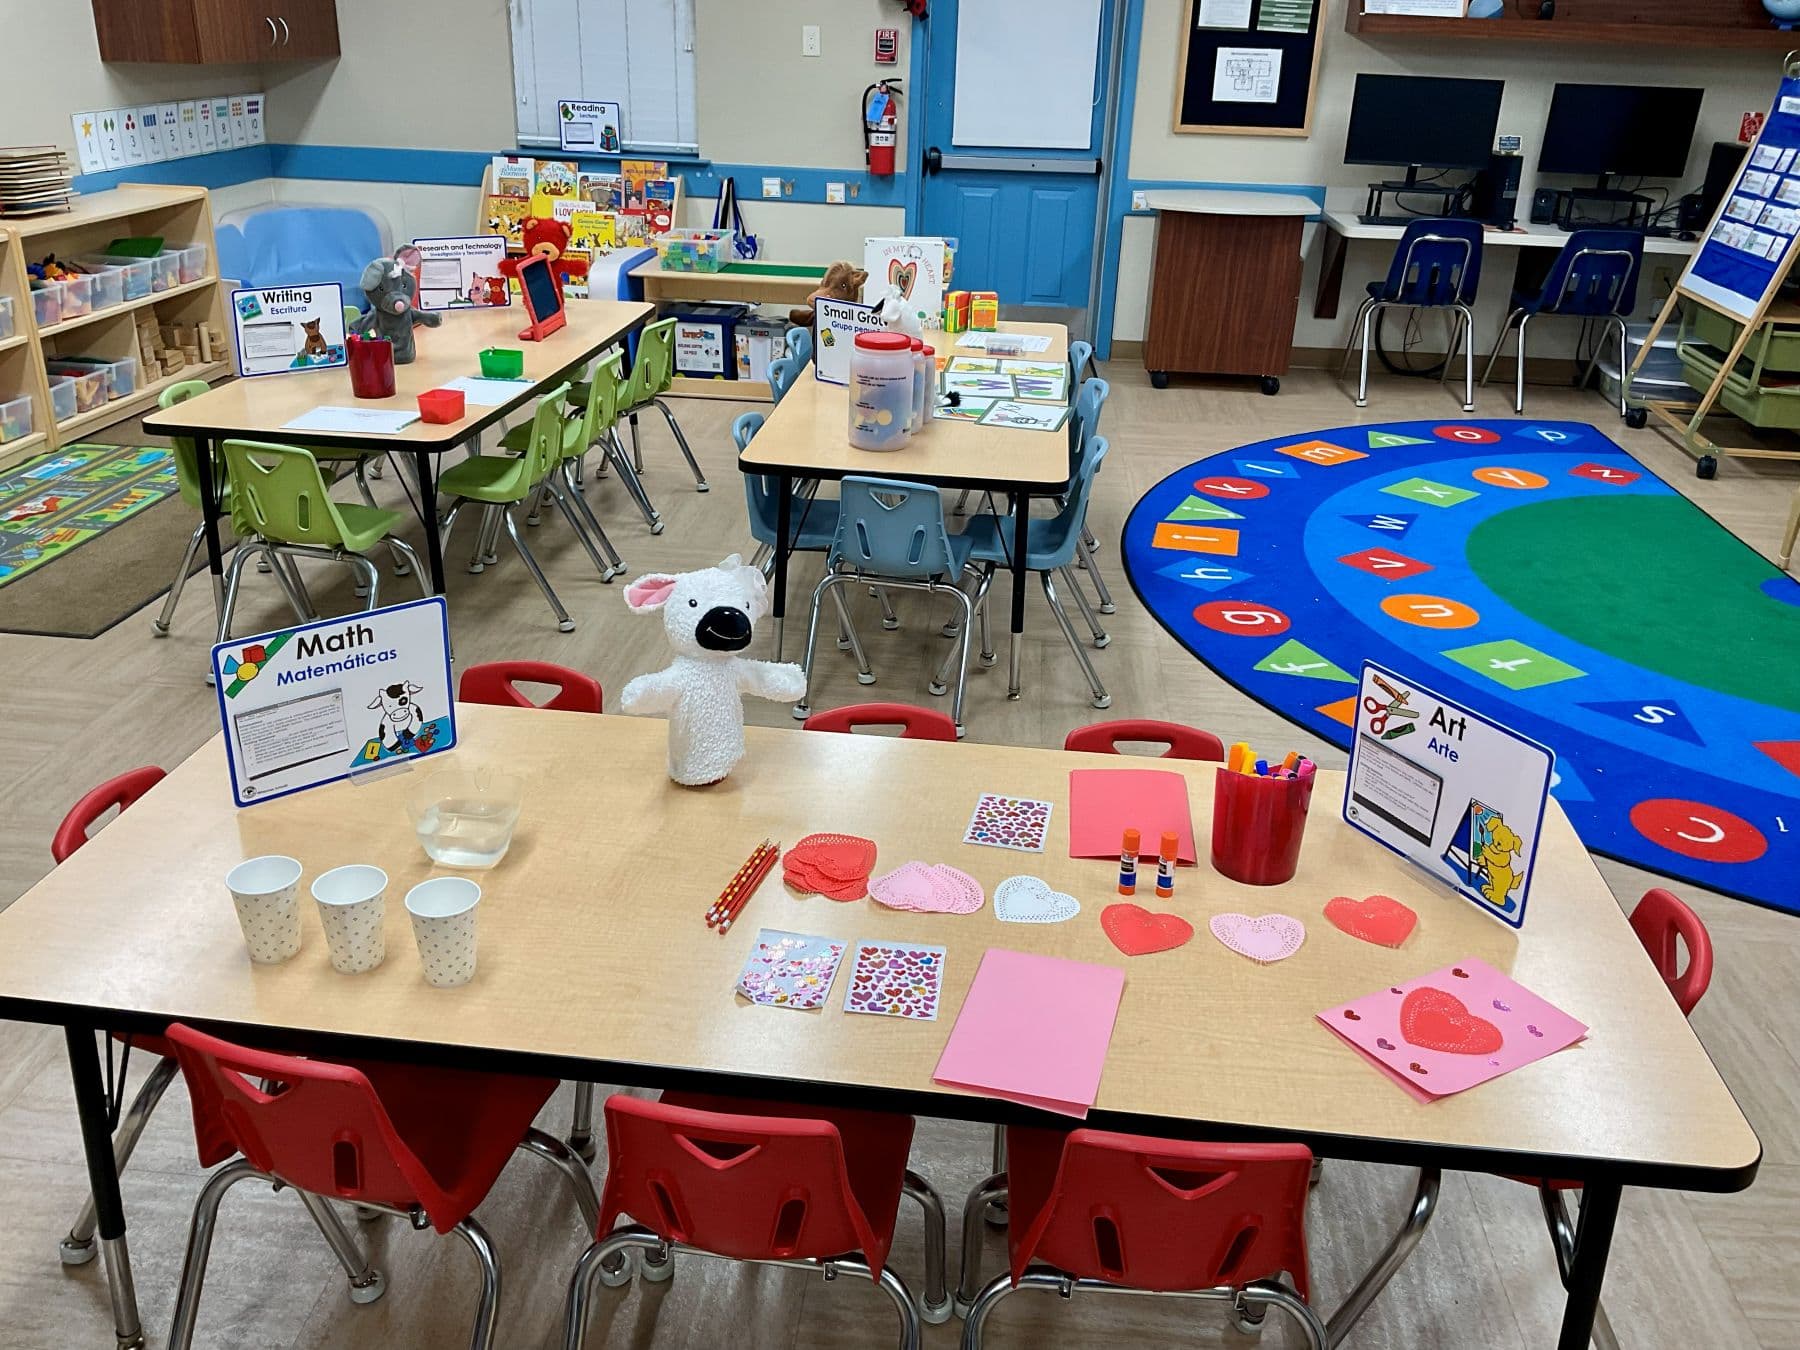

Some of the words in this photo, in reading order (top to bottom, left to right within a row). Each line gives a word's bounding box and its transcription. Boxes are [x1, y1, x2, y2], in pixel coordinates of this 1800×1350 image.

[877, 30, 895, 39] FIRE
[571, 103, 605, 114] Reading
[204, 124, 209, 136] 7
[221, 122, 227, 135] 8
[237, 120, 242, 130] 9
[251, 118, 258, 129] 10
[149, 133, 156, 144] 4
[169, 129, 176, 142] 5
[188, 127, 193, 139] 6
[87, 140, 92, 153] 1
[108, 138, 116, 151] 2
[129, 135, 137, 148] 3
[450, 243, 464, 251] and
[465, 242, 502, 250] Technology
[262, 290, 312, 304] Writing
[270, 306, 307, 315] Escritura
[823, 304, 854, 321] Small
[857, 311, 888, 327] Grou
[831, 320, 853, 331] Grupo
[1375, 434, 1410, 446] n
[1453, 430, 1483, 440] o
[1299, 446, 1346, 461] m
[1487, 470, 1527, 486] y
[1590, 467, 1625, 479] z
[1204, 482, 1253, 495] k
[1412, 485, 1453, 499] x
[1181, 505, 1238, 519] j
[1367, 514, 1409, 531] w
[1170, 534, 1220, 542] i
[1367, 556, 1407, 569] v
[1180, 566, 1233, 580] h
[1408, 603, 1454, 618] u
[1220, 610, 1283, 626] g
[296, 623, 375, 660] Math
[276, 648, 398, 686] Matemáticas
[1269, 661, 1330, 674] f
[1487, 657, 1533, 672] t
[1633, 704, 1677, 725] s
[1428, 706, 1467, 741] Art
[1426, 736, 1460, 763] Arte
[1676, 815, 1726, 844] c
